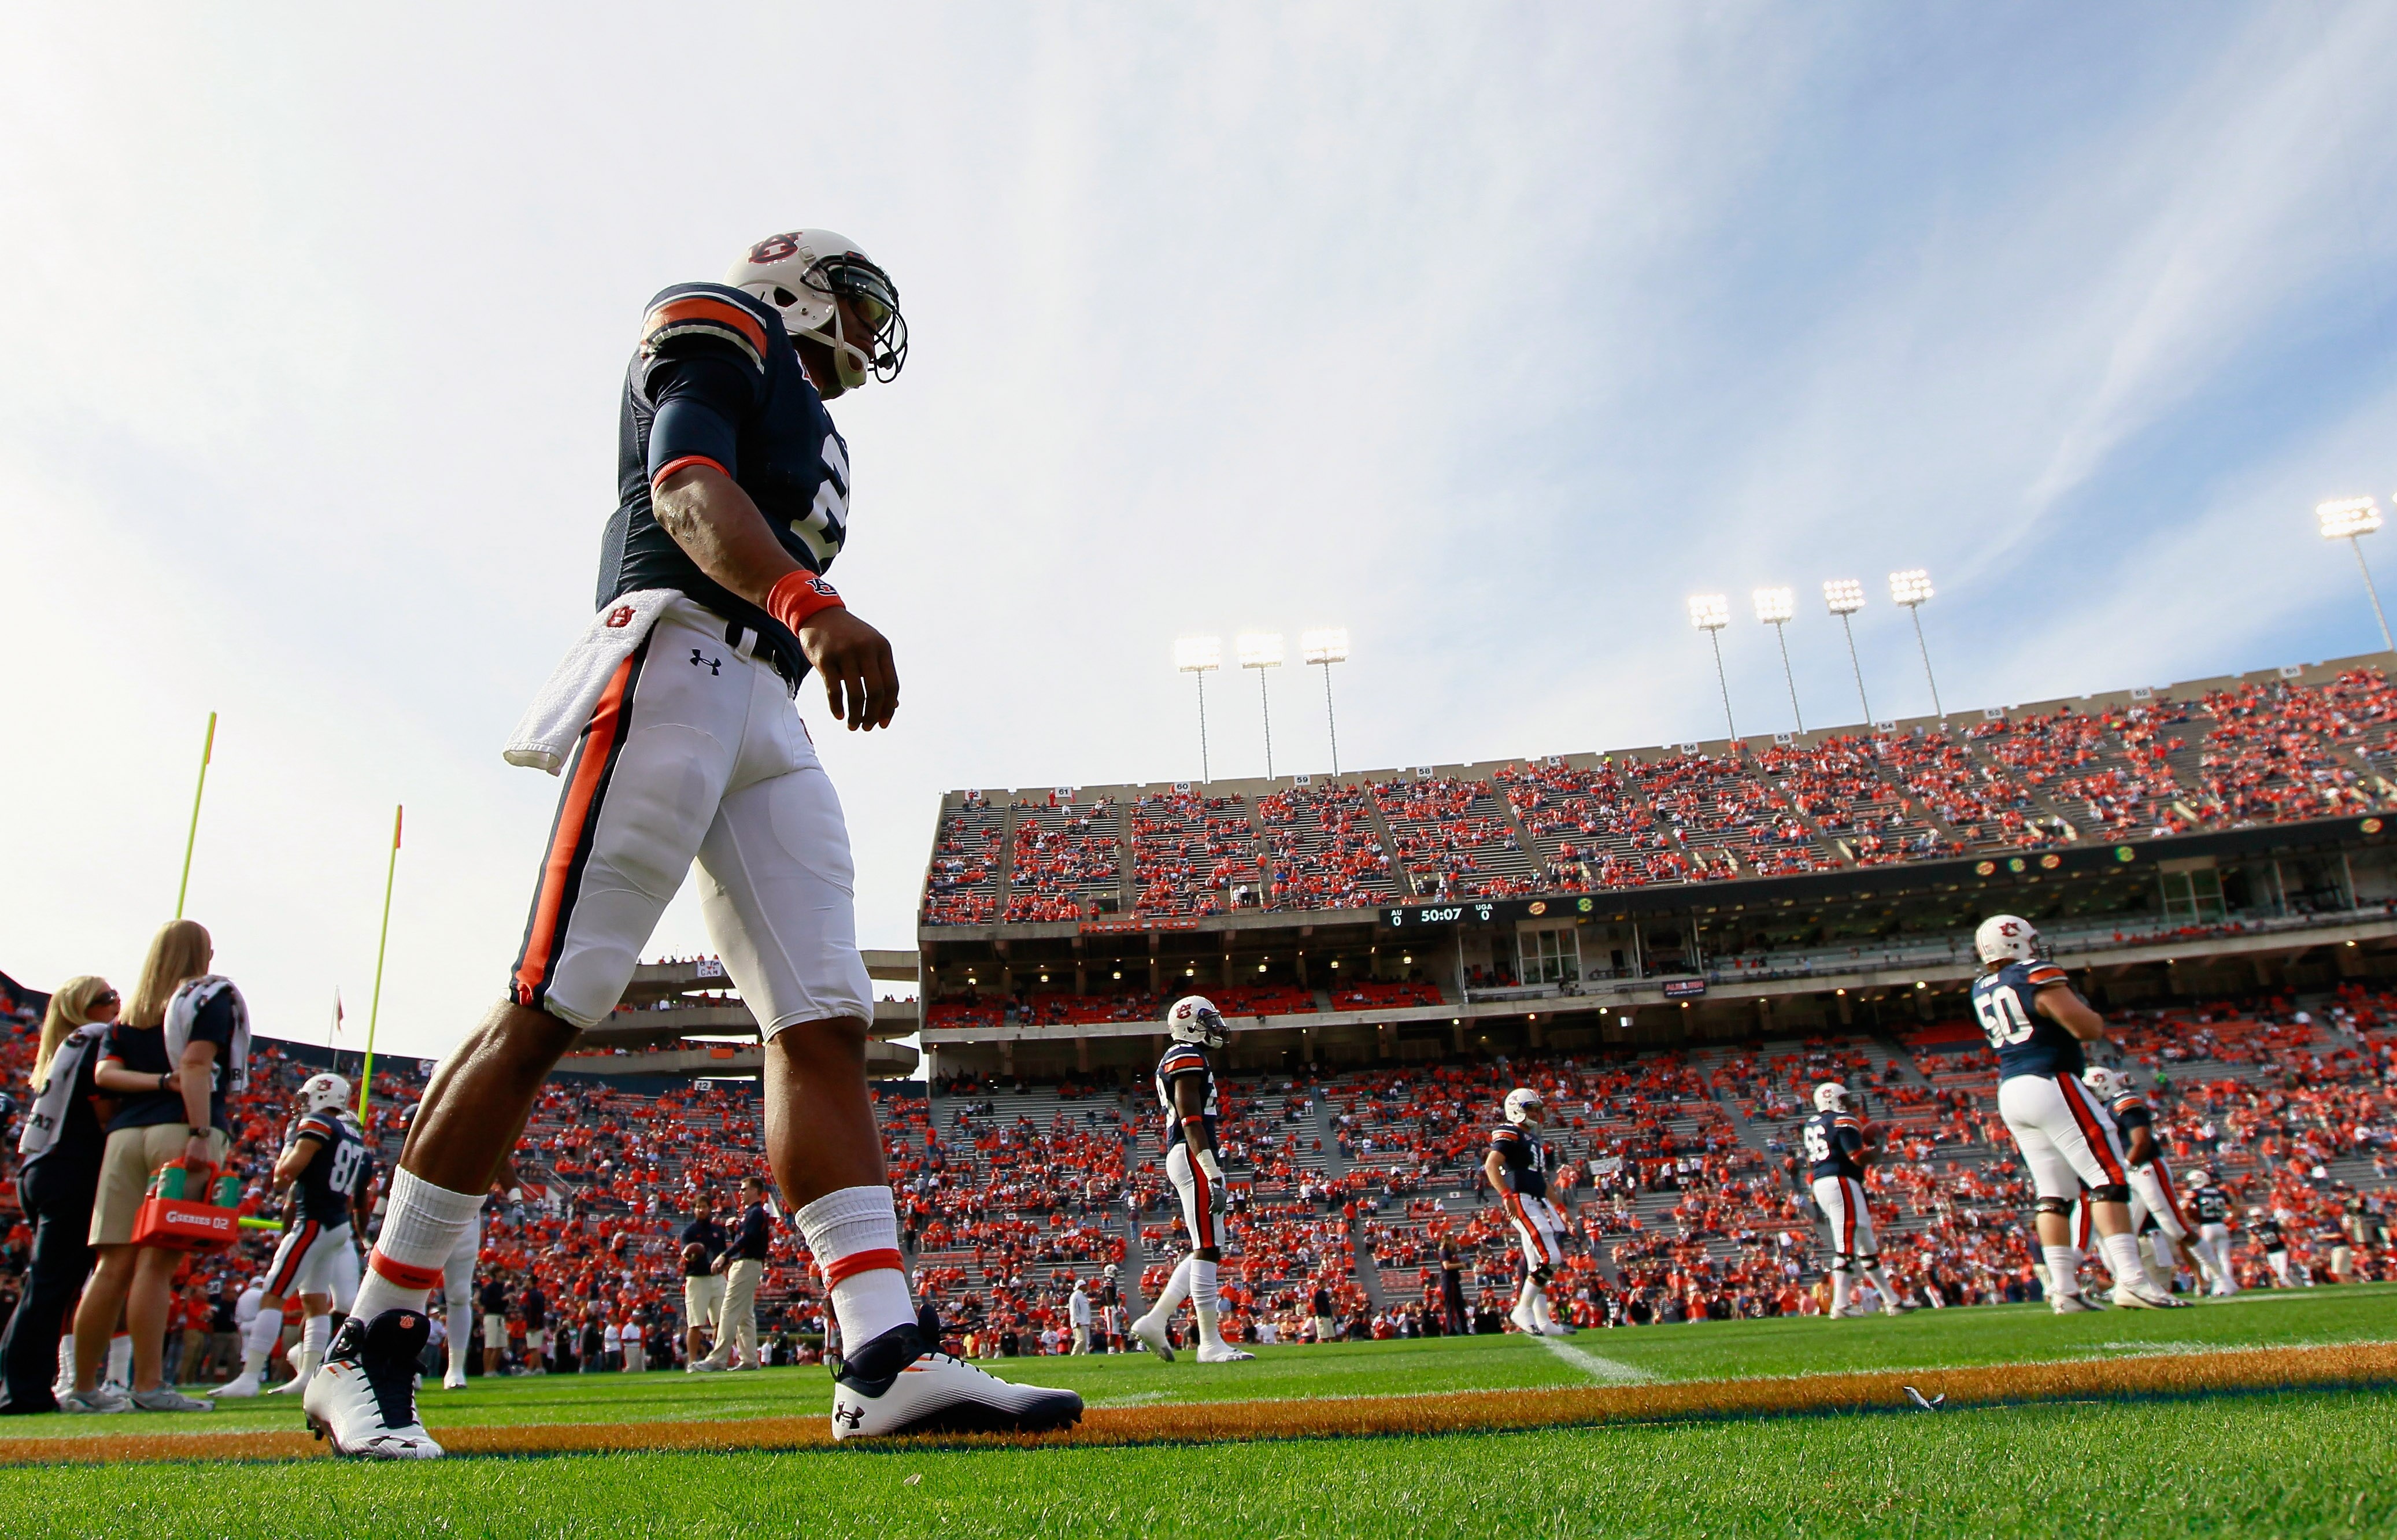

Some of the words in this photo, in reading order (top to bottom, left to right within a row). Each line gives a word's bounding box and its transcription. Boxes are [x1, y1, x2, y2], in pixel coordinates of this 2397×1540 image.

[1393, 916, 1401, 926] 0
[1421, 908, 1462, 922] 50:07
[1481, 910, 1490, 920] 0
[1079, 921, 1109, 934] PAT
[1112, 920, 1145, 932] DYE
[1151, 917, 1199, 930] FIELD
[1973, 984, 2034, 1049] 50
[329, 1138, 365, 1196] 87
[212, 1217, 230, 1230] 02
